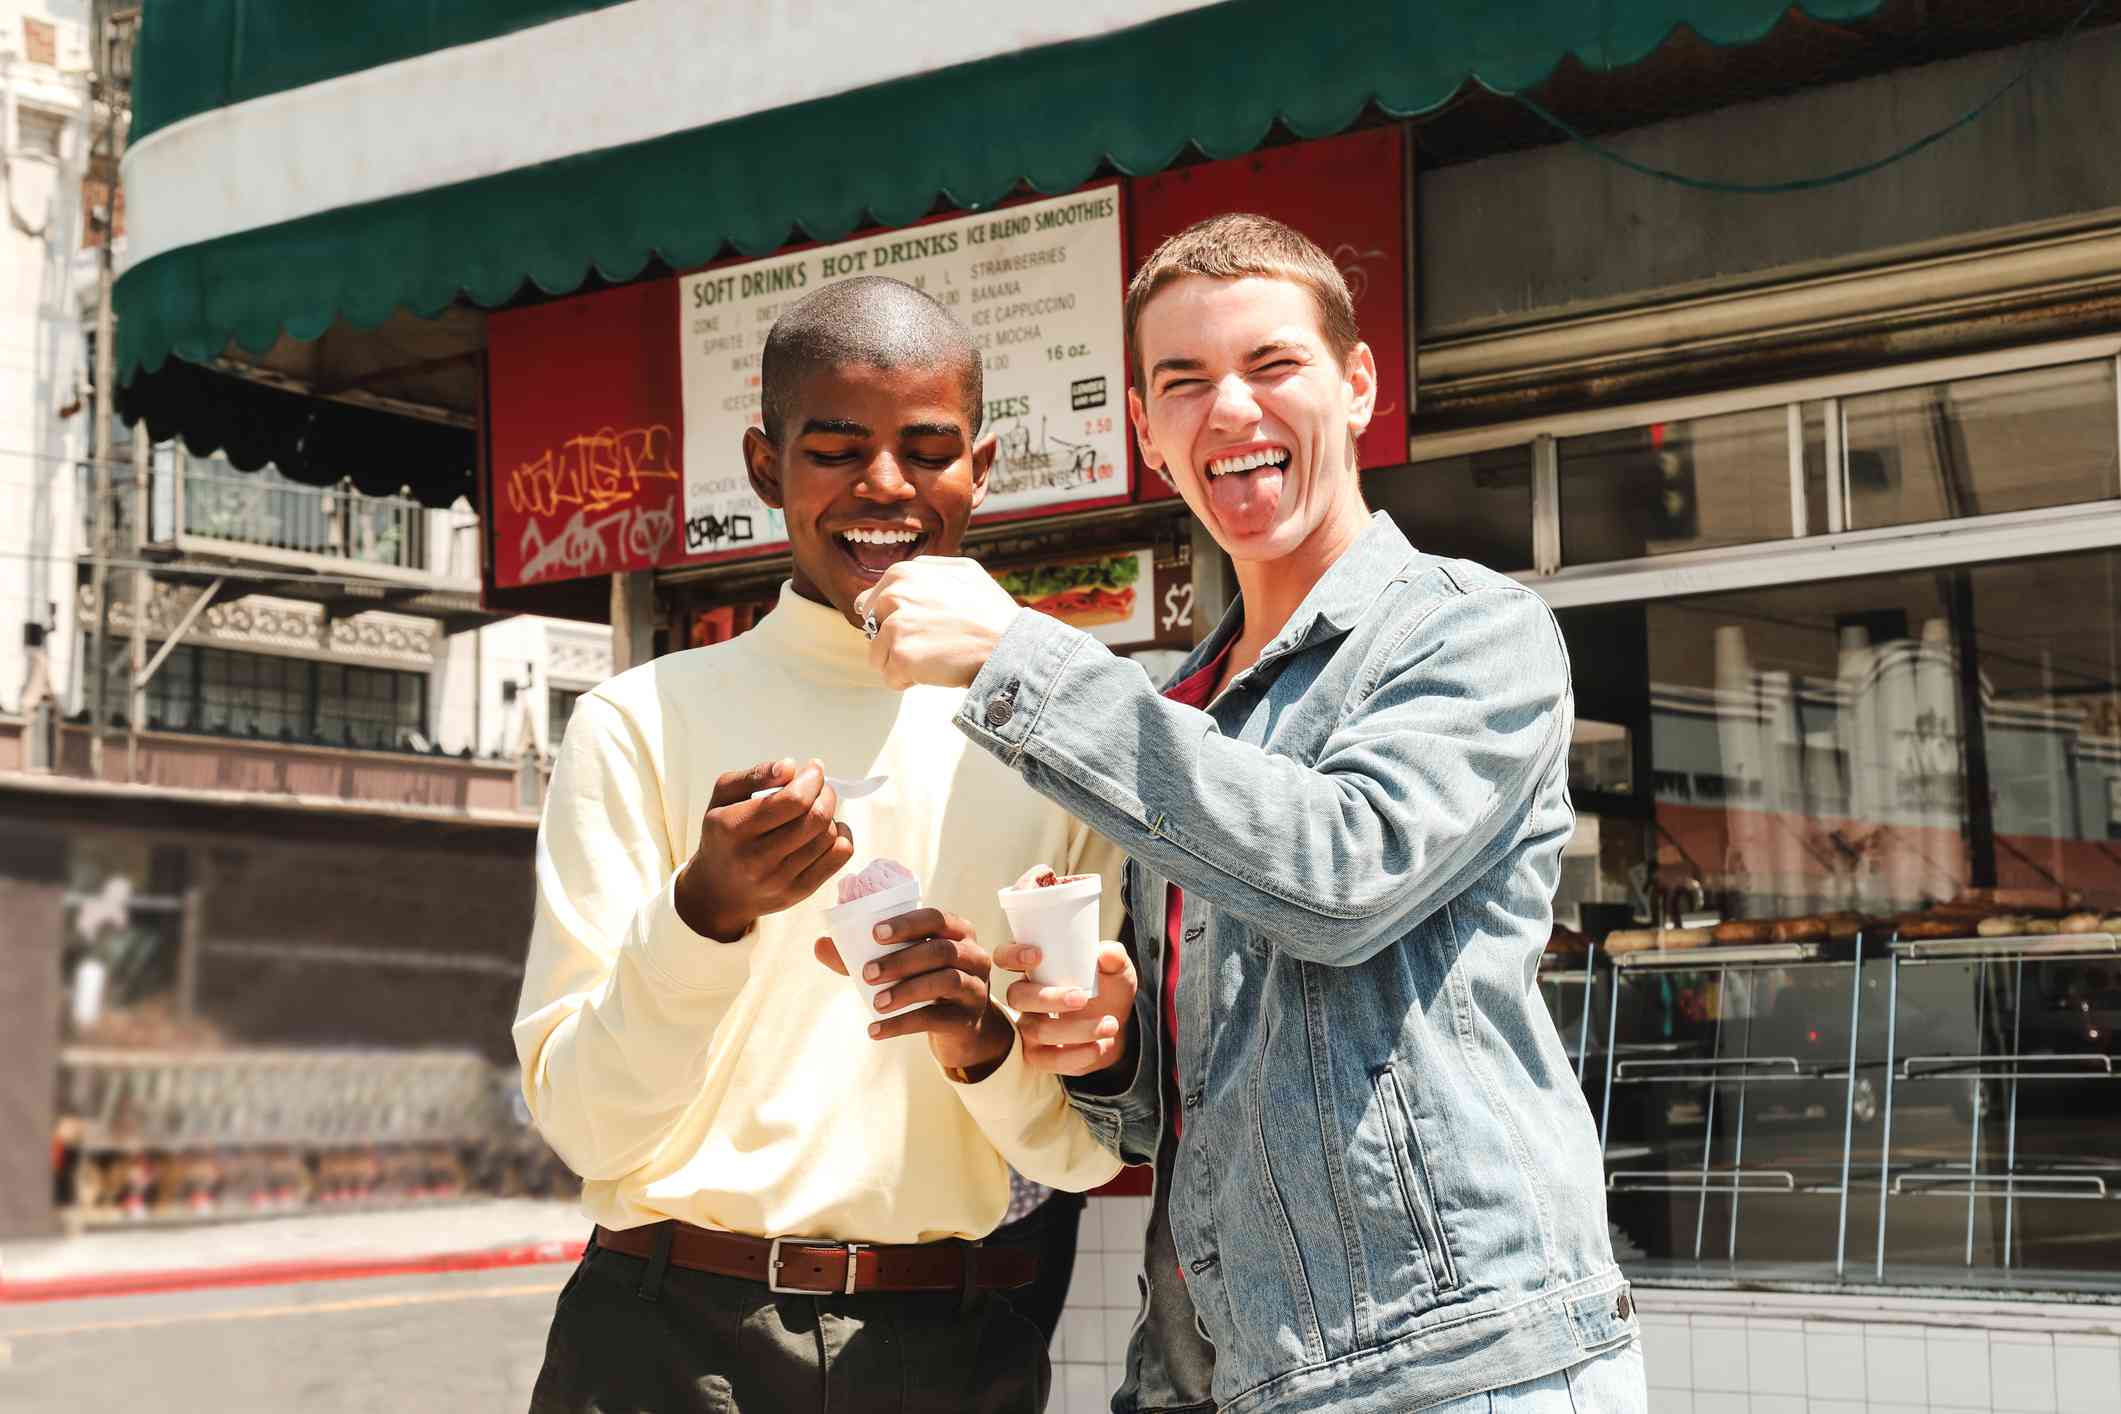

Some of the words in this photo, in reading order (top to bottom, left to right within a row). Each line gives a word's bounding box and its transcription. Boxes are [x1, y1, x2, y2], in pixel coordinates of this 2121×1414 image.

[967, 224, 985, 245] ICE
[989, 216, 1031, 240] BLEND
[1035, 197, 1114, 232] SMOOTHIES
[822, 251, 867, 278] HOT
[874, 232, 959, 267] DRINKS
[970, 246, 1067, 280] STRAWBERRIES
[694, 276, 735, 308] SOFT
[741, 262, 807, 298] DRINKS
[971, 280, 1021, 303] BANANA
[971, 310, 990, 327] ICE
[995, 293, 1077, 323] CAPPUCCINO
[995, 324, 1041, 345] MOCHA
[1046, 345, 1064, 361] 16
[1161, 582, 1195, 632] $2
